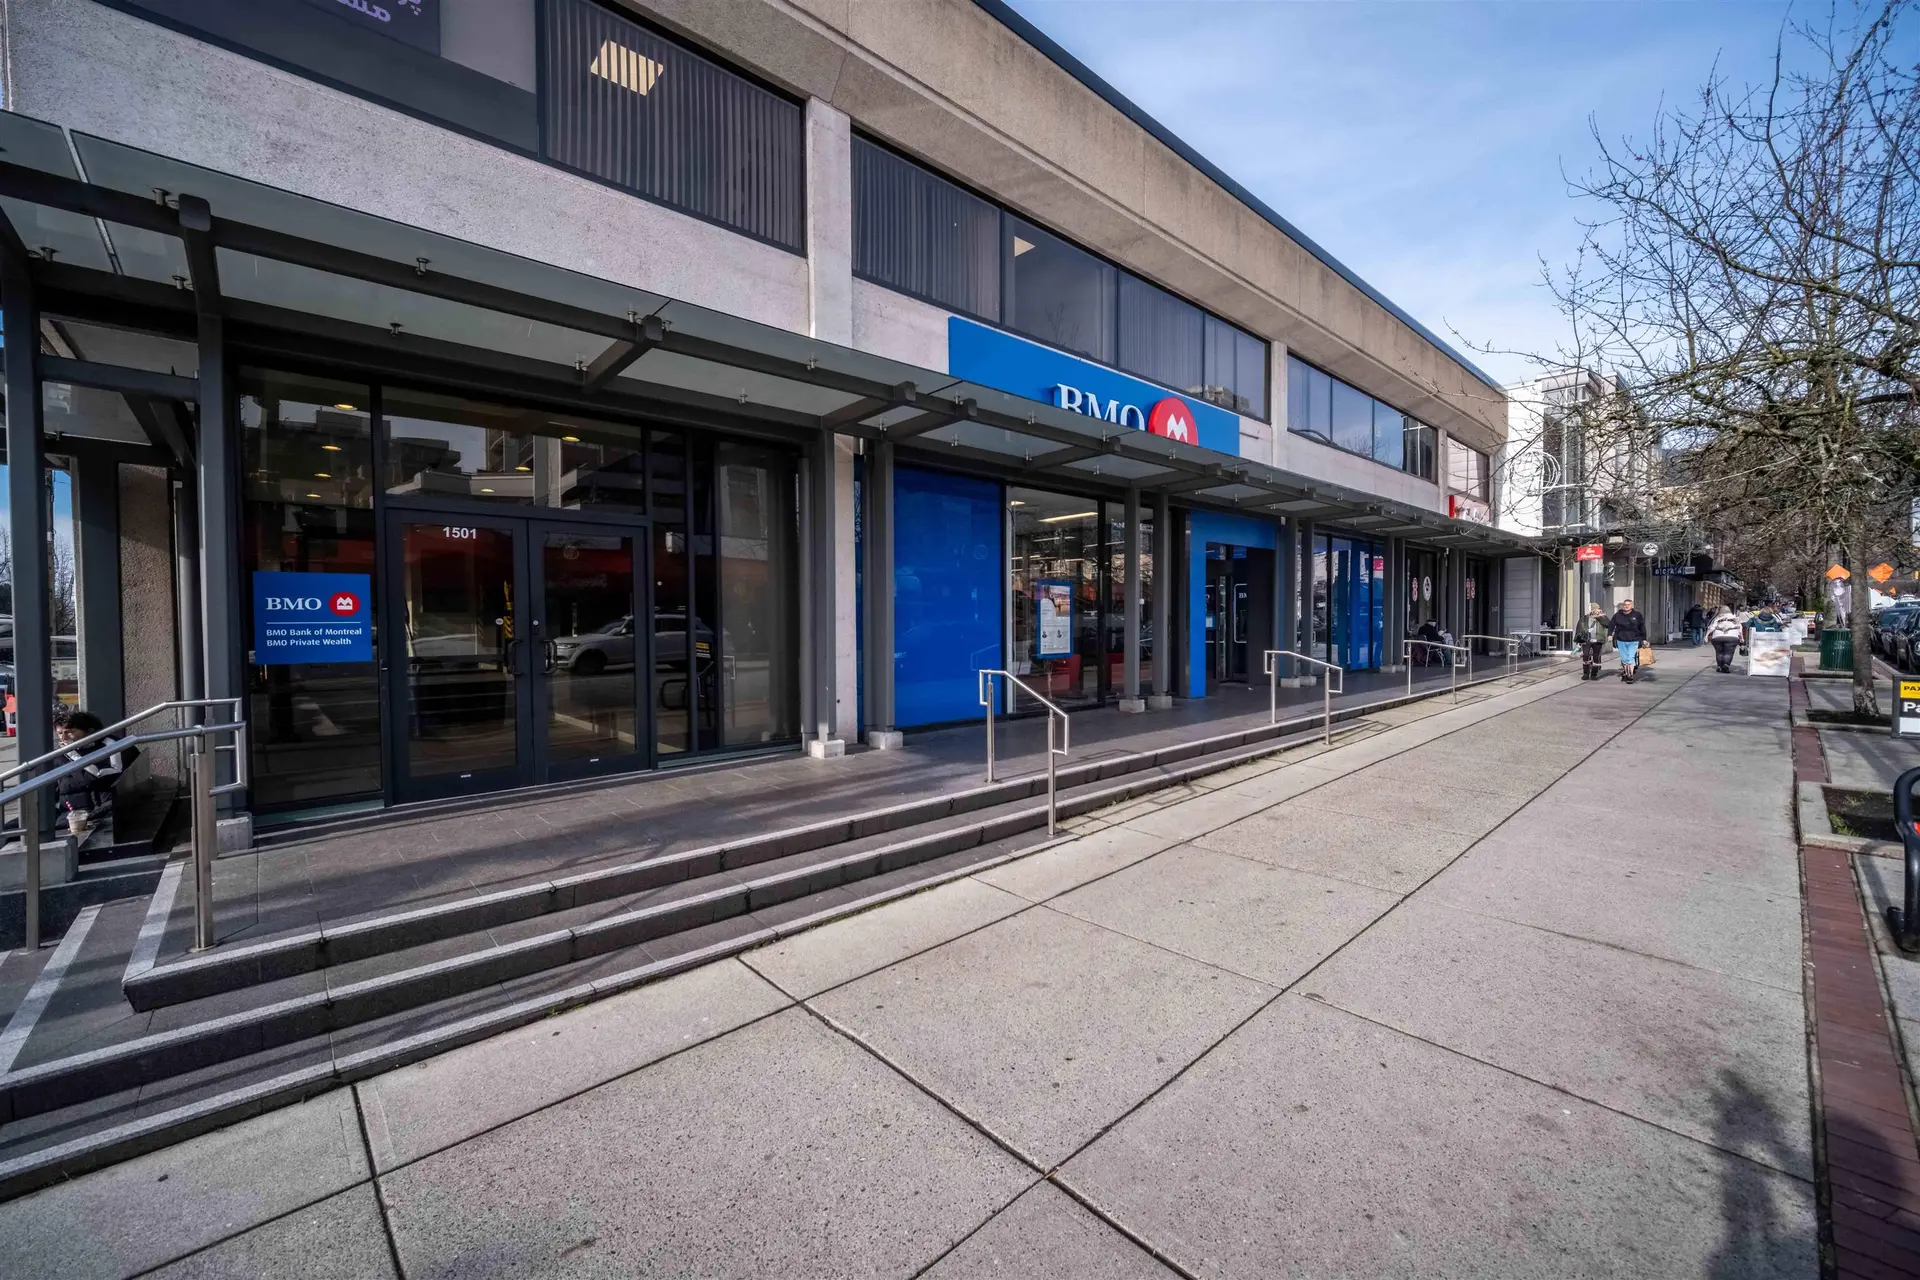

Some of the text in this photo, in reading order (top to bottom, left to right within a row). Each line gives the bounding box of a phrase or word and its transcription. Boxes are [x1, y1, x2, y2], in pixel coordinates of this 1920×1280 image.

[443, 526, 477, 539] 1501
[265, 597, 322, 610] BMO
[289, 628, 312, 636] Bank
[314, 628, 323, 636] of
[325, 627, 362, 635] Montreal
[266, 639, 288, 647] BMO
[290, 638, 320, 646] Private
